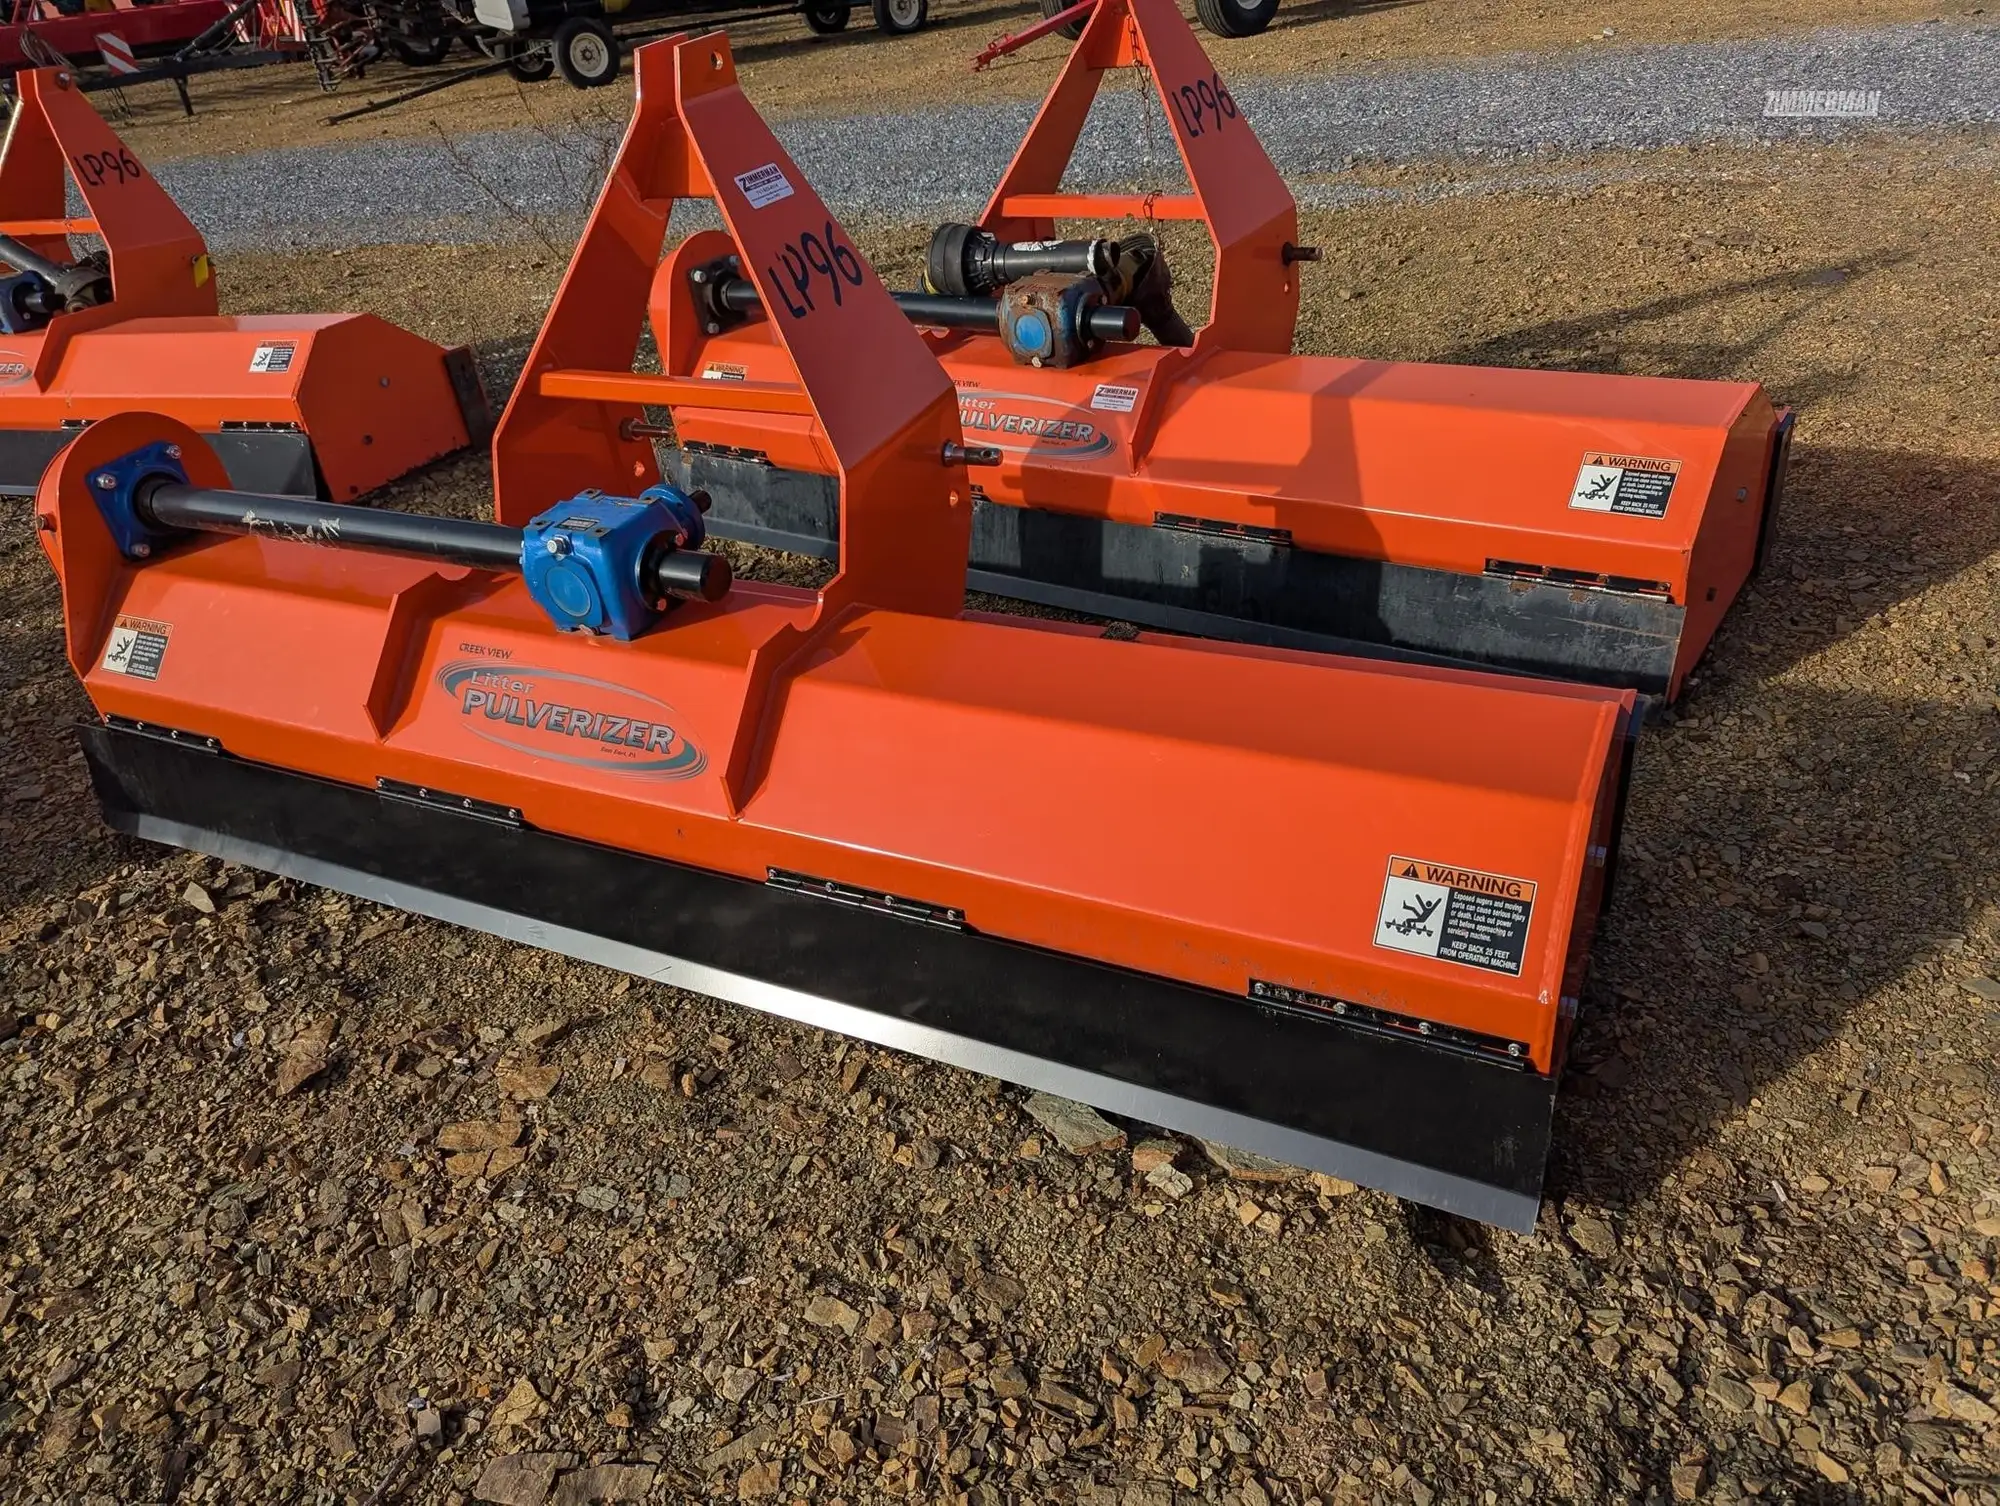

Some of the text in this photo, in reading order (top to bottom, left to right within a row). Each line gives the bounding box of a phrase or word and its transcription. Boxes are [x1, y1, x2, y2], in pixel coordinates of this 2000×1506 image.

[1172, 73, 1235, 137] LP96
[73, 148, 140, 186] LP96
[768, 221, 863, 318] LP96
[959, 396, 995, 409] itter
[958, 408, 1094, 442] ULVERIZER
[1609, 456, 1671, 472] WARNING
[130, 618, 167, 634] WARNING
[459, 643, 513, 659] CREEK VIEW
[471, 670, 534, 693] Litter
[462, 688, 675, 754] PULVERIZER
[1426, 866, 1522, 898] WARNING
[1451, 901, 1465, 909] parts
[1476, 906, 1491, 914] cause
[1492, 909, 1511, 918] serious
[1511, 912, 1526, 923] injury
[1454, 891, 1475, 902] Exposed
[1476, 897, 1492, 906] augers
[1504, 902, 1522, 913] moving
[1439, 946, 1518, 970] FROM OPERATING MACHINE.
[1451, 940, 1510, 959] KEEP BACK 25 FEET
